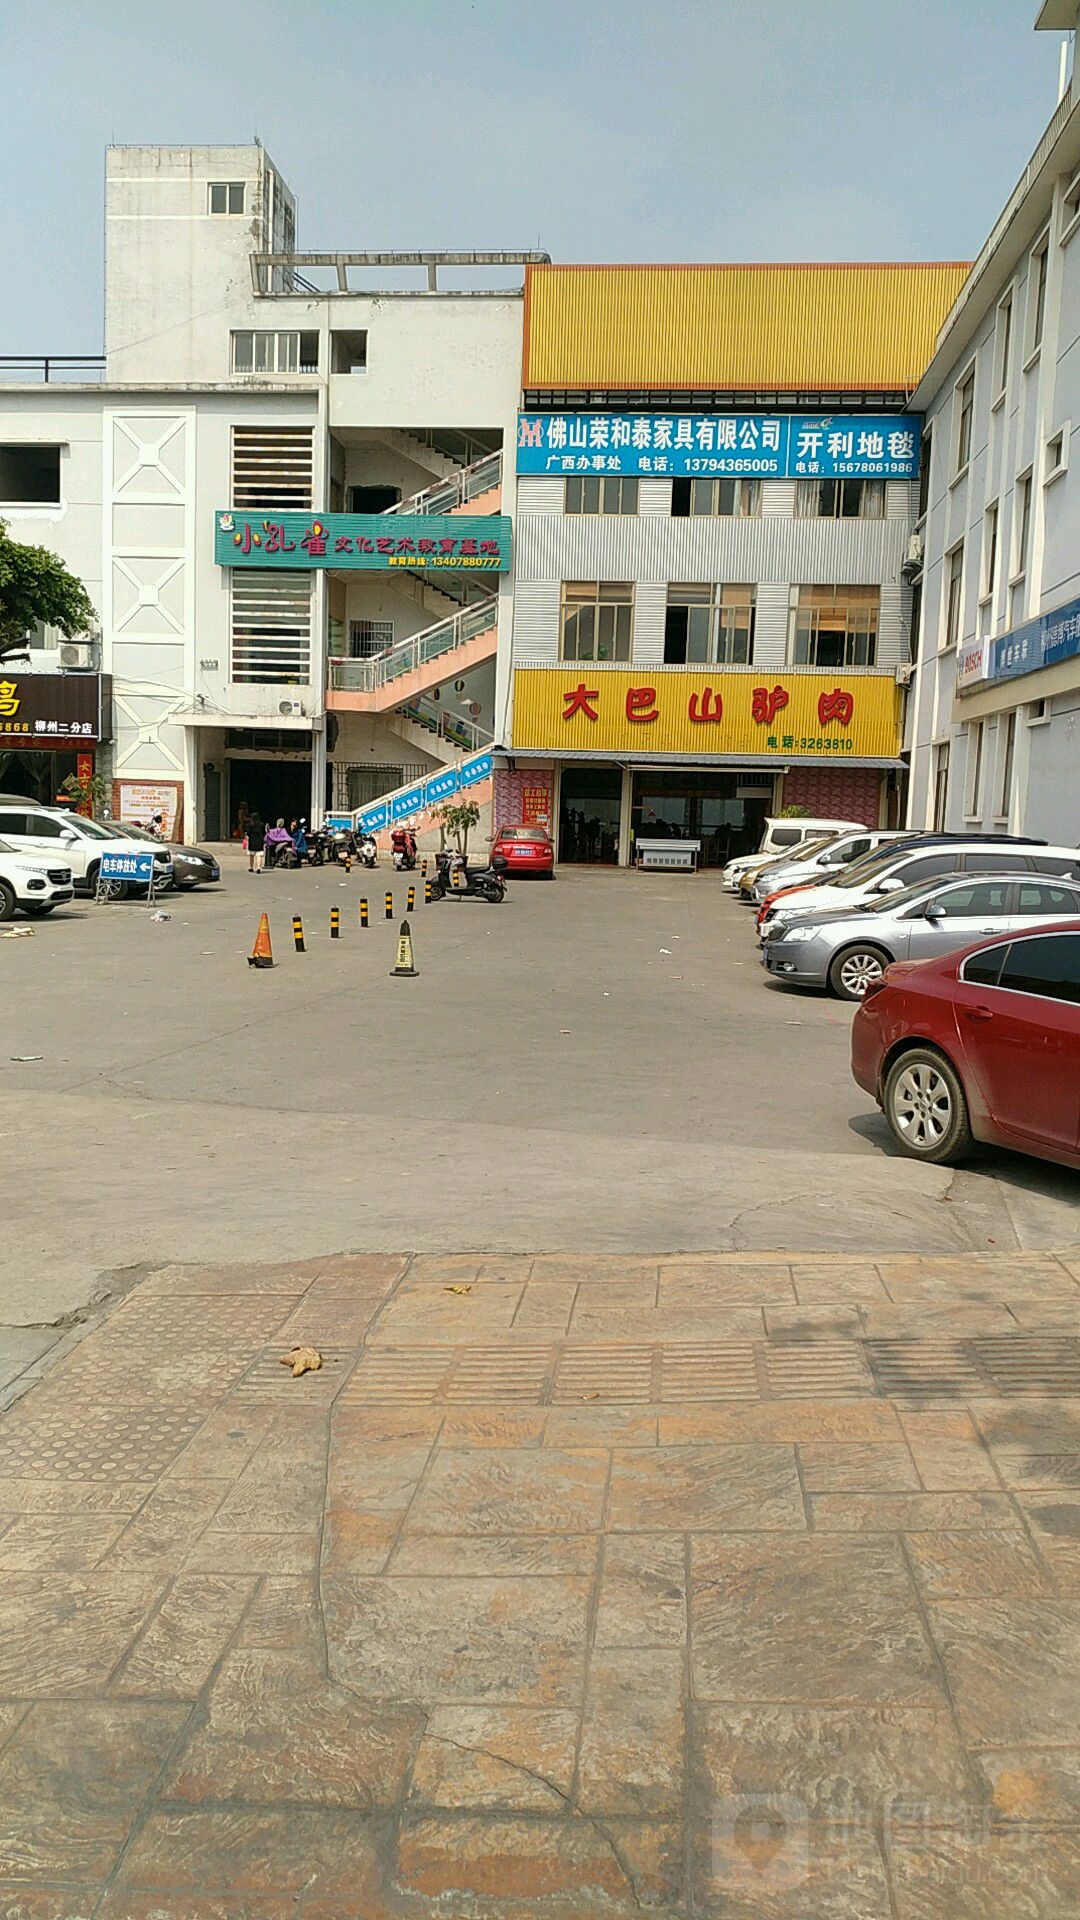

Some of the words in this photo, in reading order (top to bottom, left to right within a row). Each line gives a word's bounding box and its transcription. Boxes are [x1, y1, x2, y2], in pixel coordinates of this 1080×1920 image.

[546, 416, 781, 451] 佛山荣和泰家具有限公司
[796, 431, 915, 459] 开利地毯
[546, 455, 622, 471] 广西办事处
[561, 683, 855, 726] 大巴山驴肉
[35, 720, 93, 734] 柳州二分店
